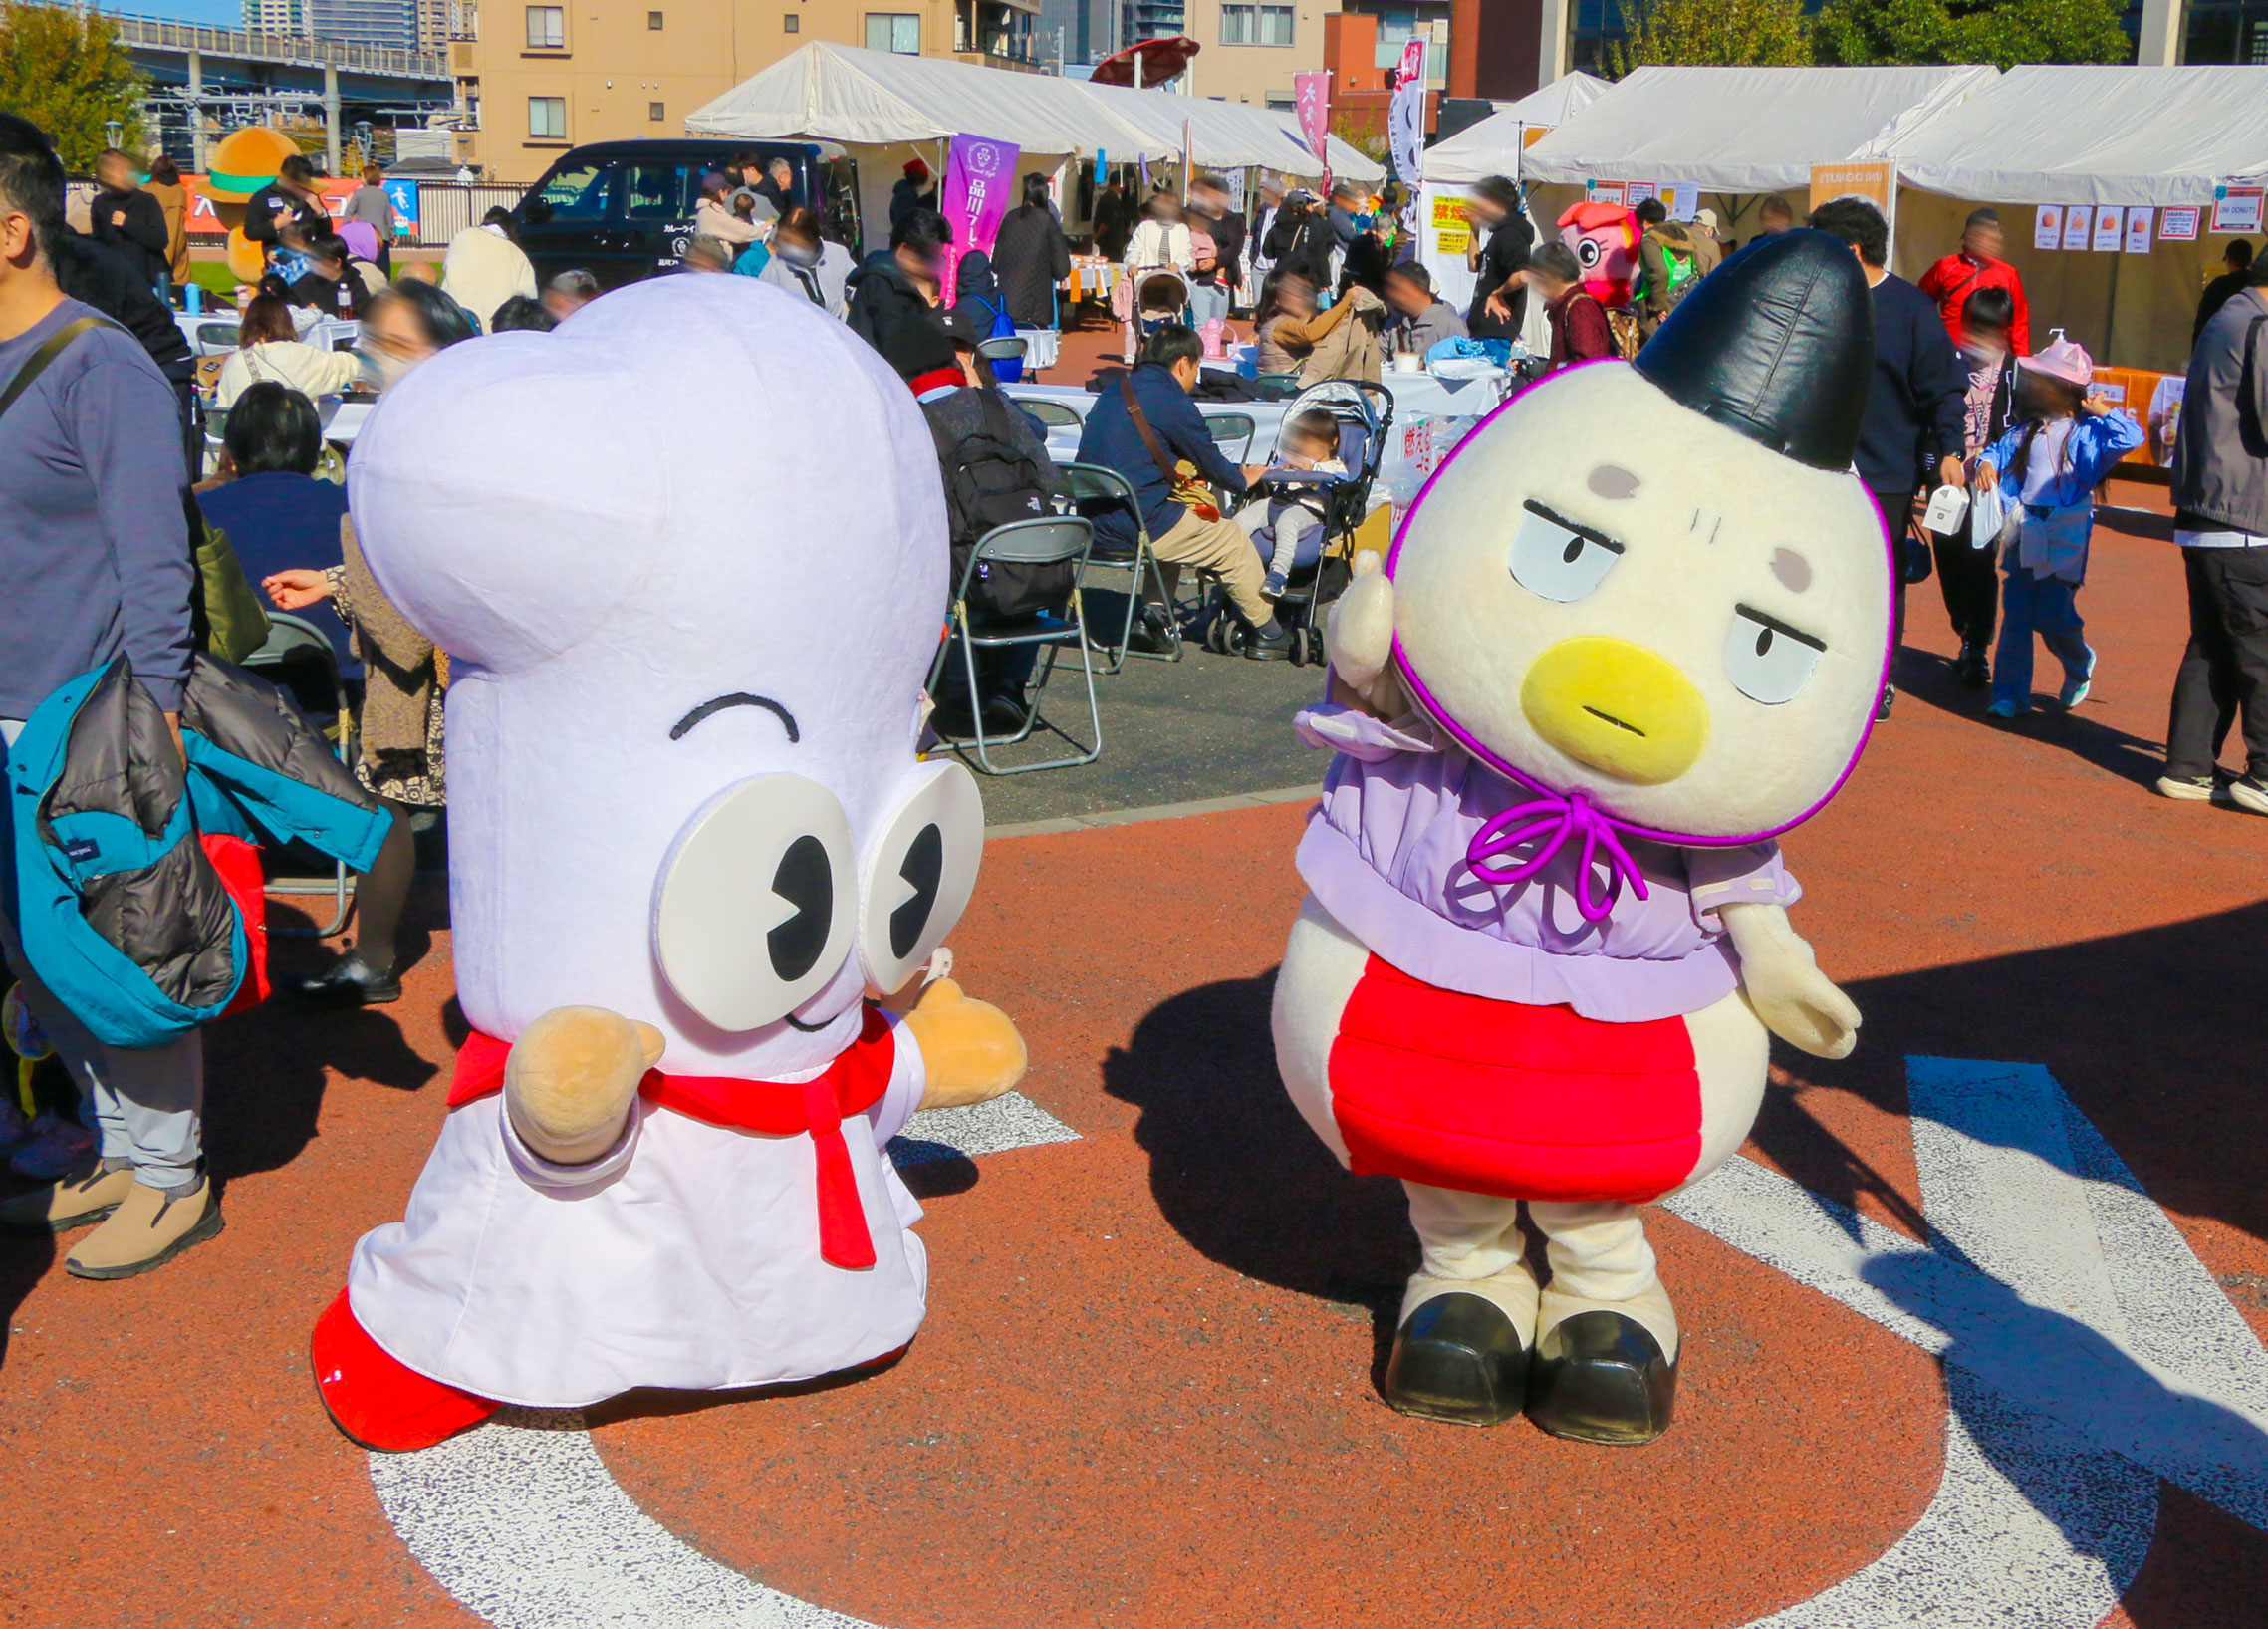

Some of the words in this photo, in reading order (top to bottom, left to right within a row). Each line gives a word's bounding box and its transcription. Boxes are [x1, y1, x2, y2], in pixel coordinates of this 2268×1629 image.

[663, 224, 695, 233] カレーライ
